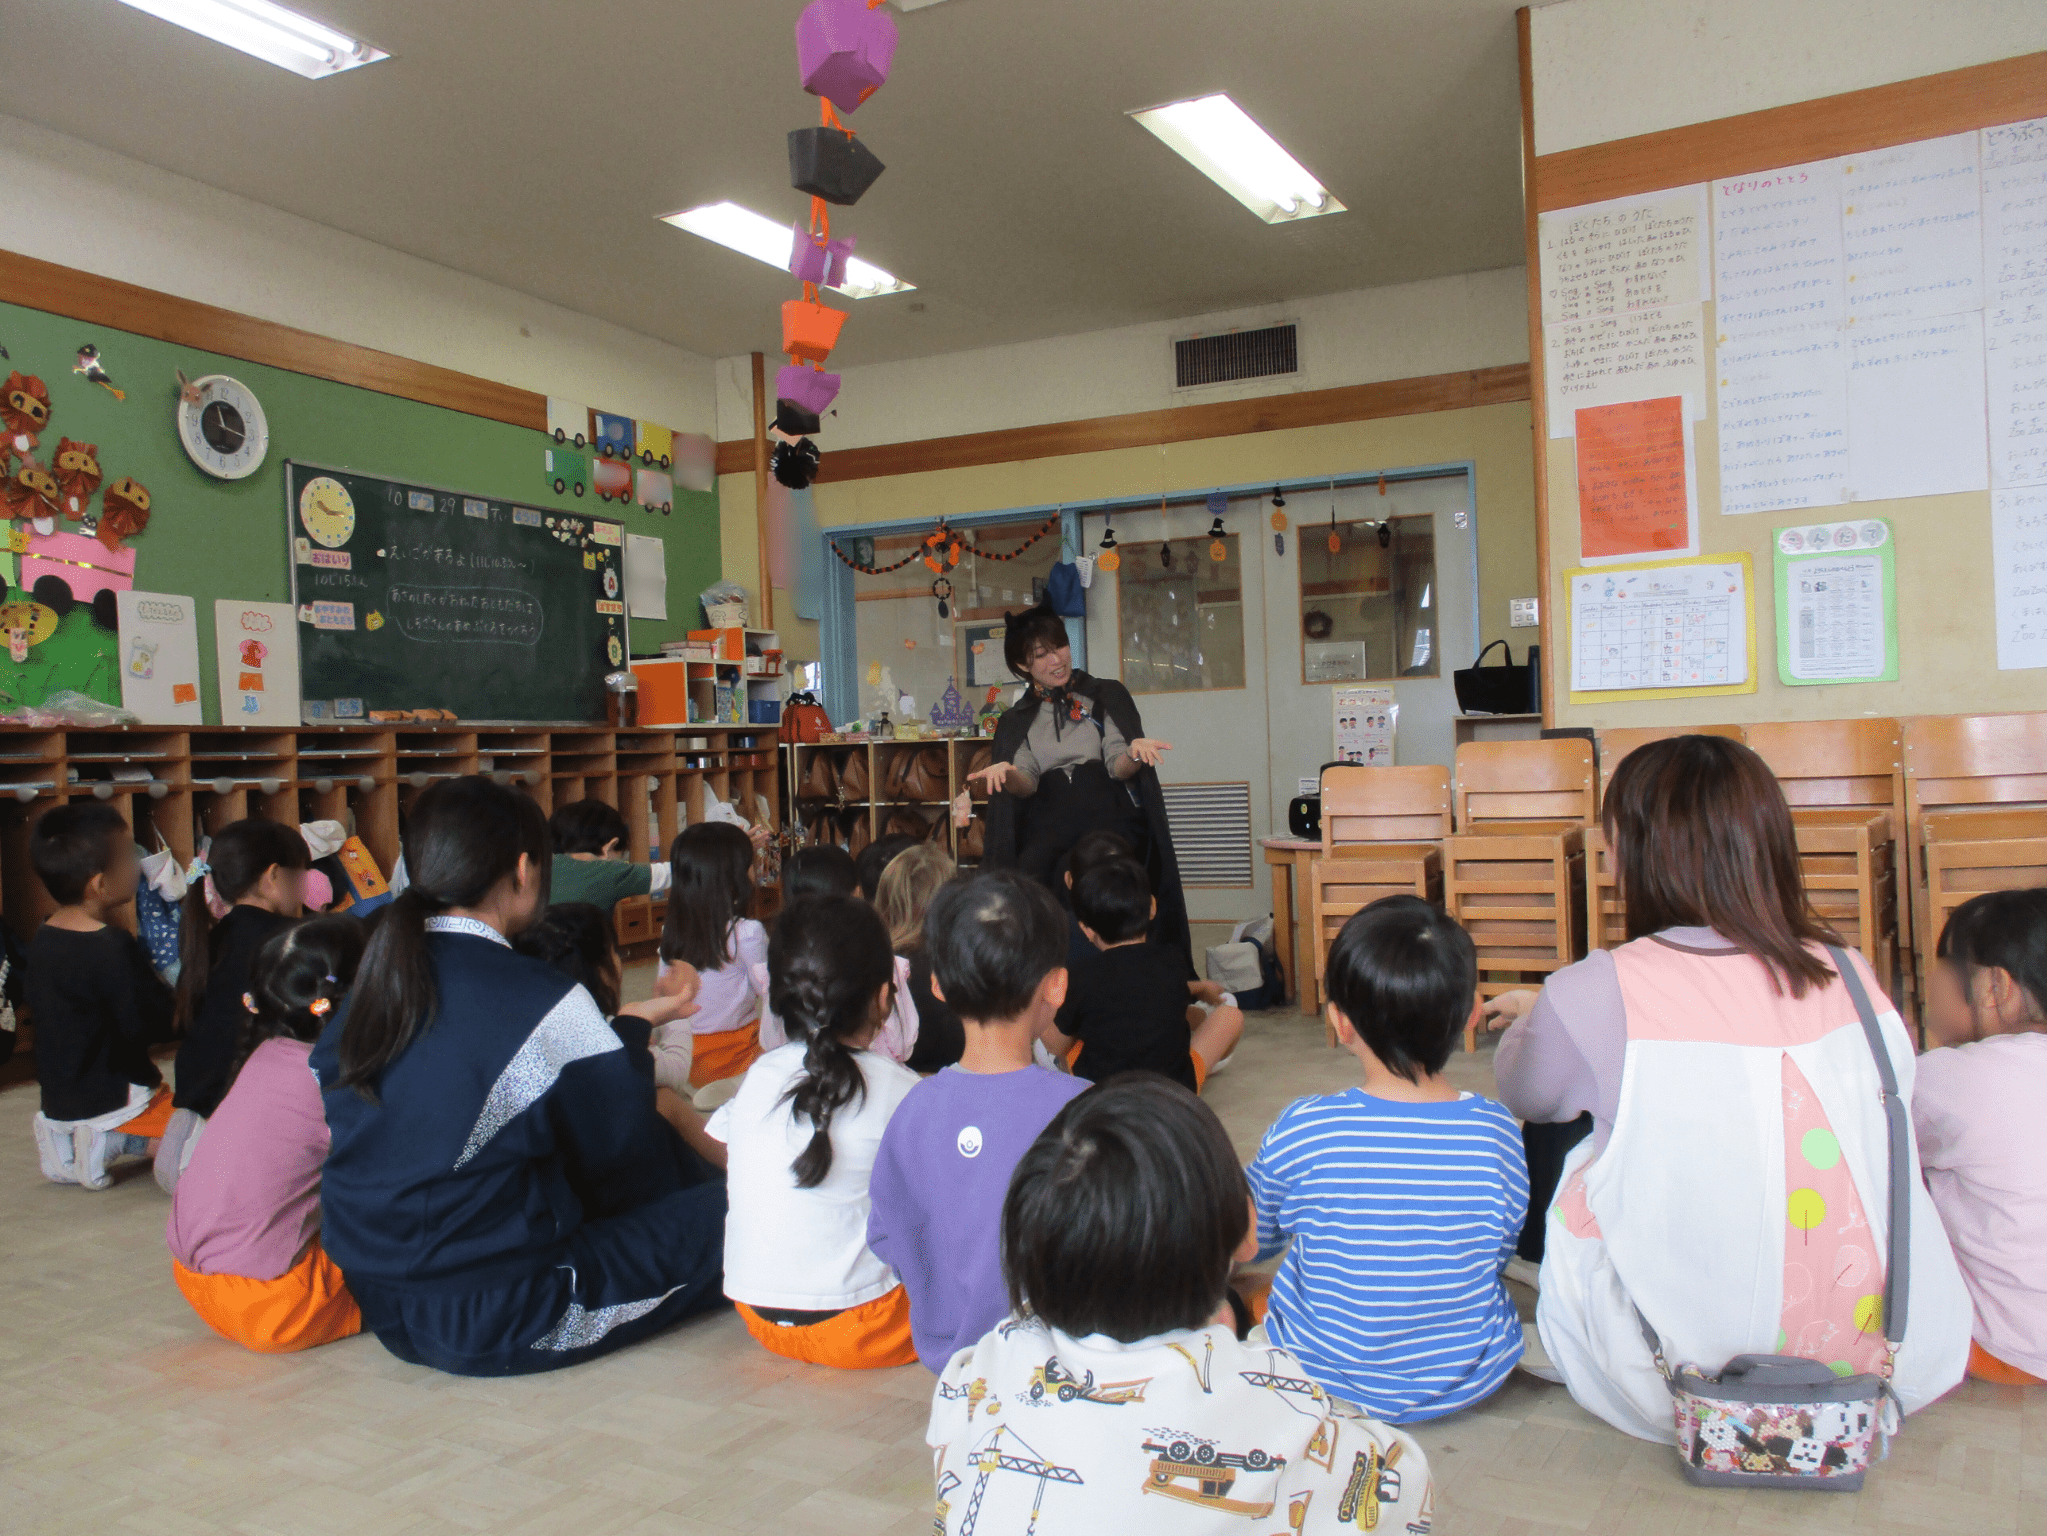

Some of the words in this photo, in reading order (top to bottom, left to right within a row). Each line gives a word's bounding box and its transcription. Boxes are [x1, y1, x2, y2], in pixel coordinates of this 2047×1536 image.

[1986, 122, 2047, 146] どうぶつ
[245, 412, 251, 423] 2
[195, 433, 202, 445] 8
[206, 447, 211, 460] 7
[219, 456, 226, 468] 6
[388, 489, 403, 506] 10
[440, 498, 456, 516] 29
[608, 576, 615, 591] A
